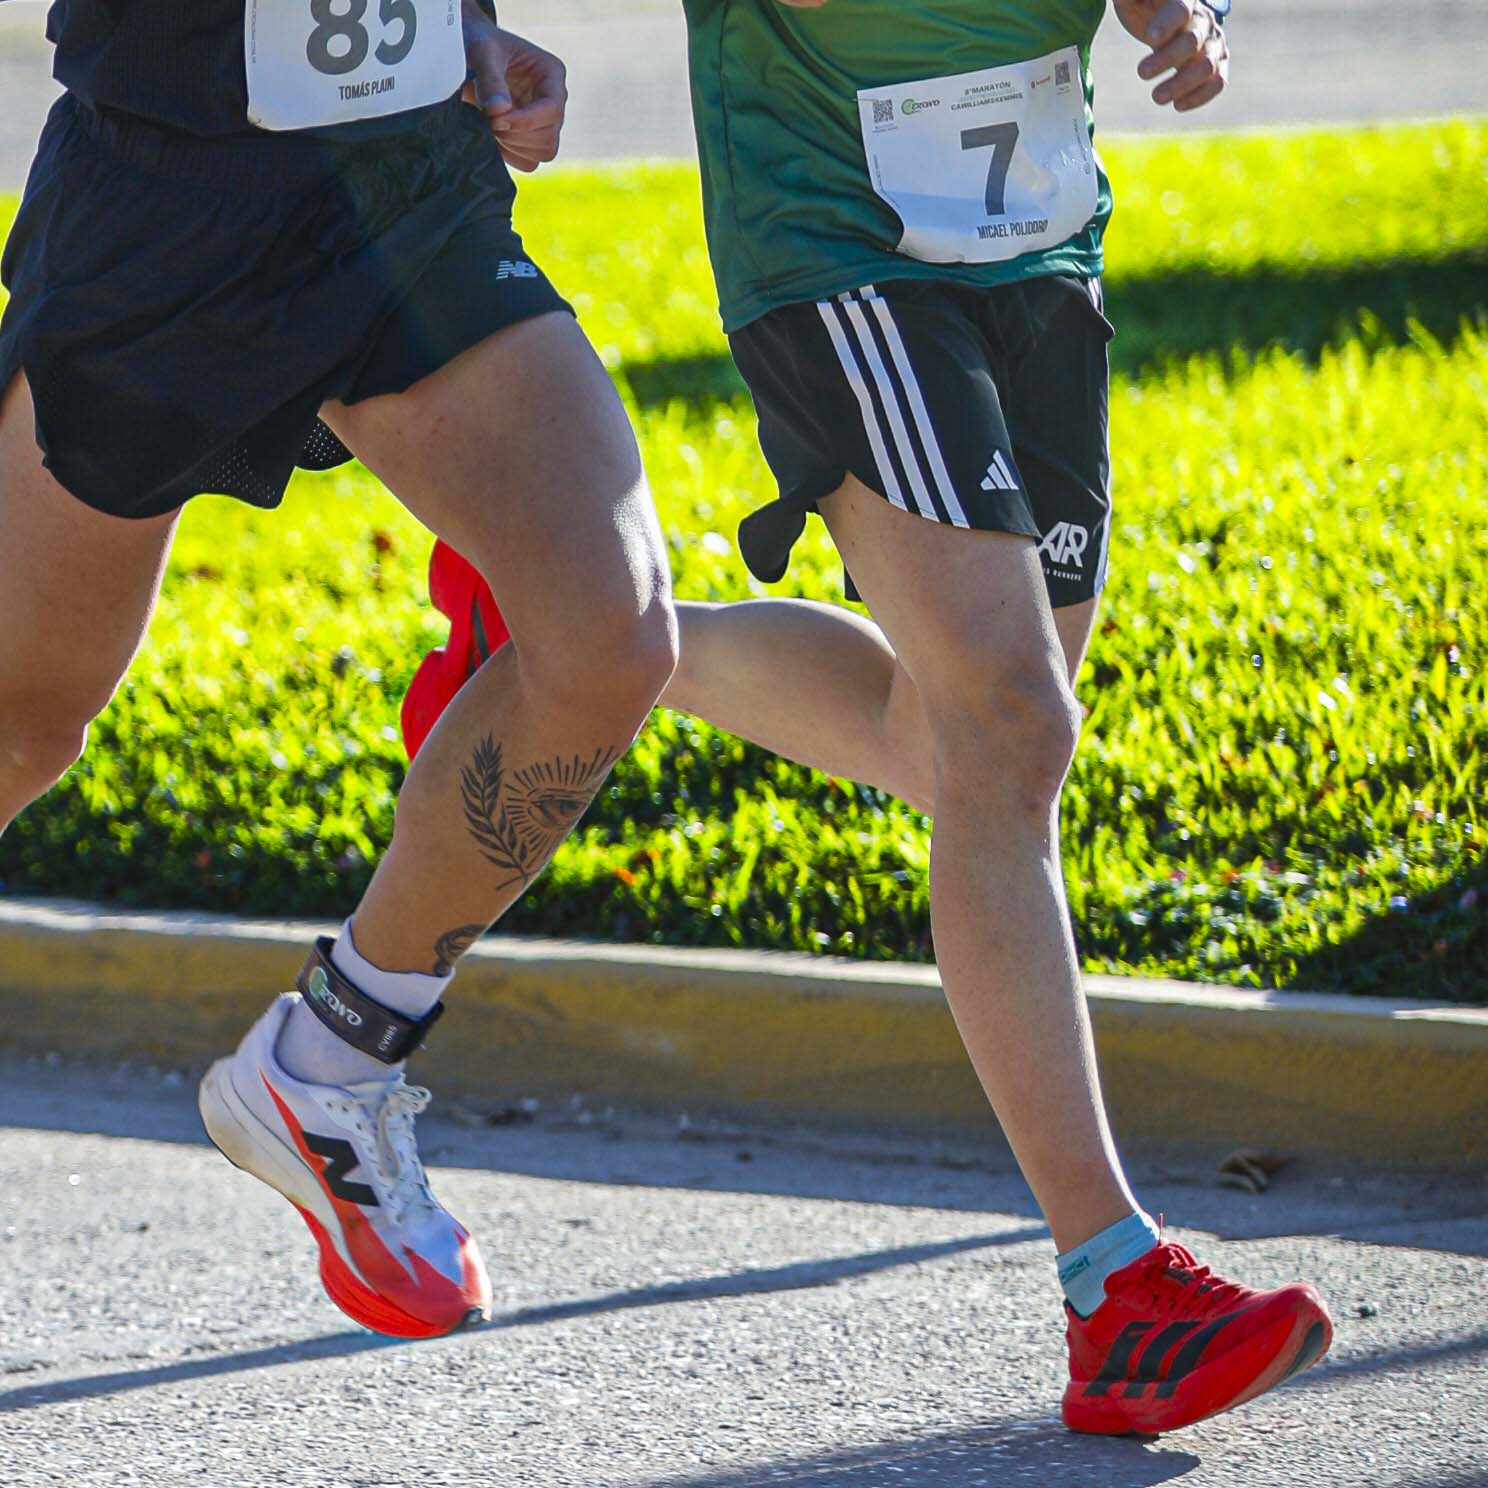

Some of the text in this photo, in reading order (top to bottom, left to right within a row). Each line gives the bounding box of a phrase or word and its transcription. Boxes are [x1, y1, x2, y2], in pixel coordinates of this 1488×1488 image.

[338, 80, 370, 101] TOMÁS
[960, 121, 1020, 216] 7
[977, 223, 1008, 239] MICAEL
